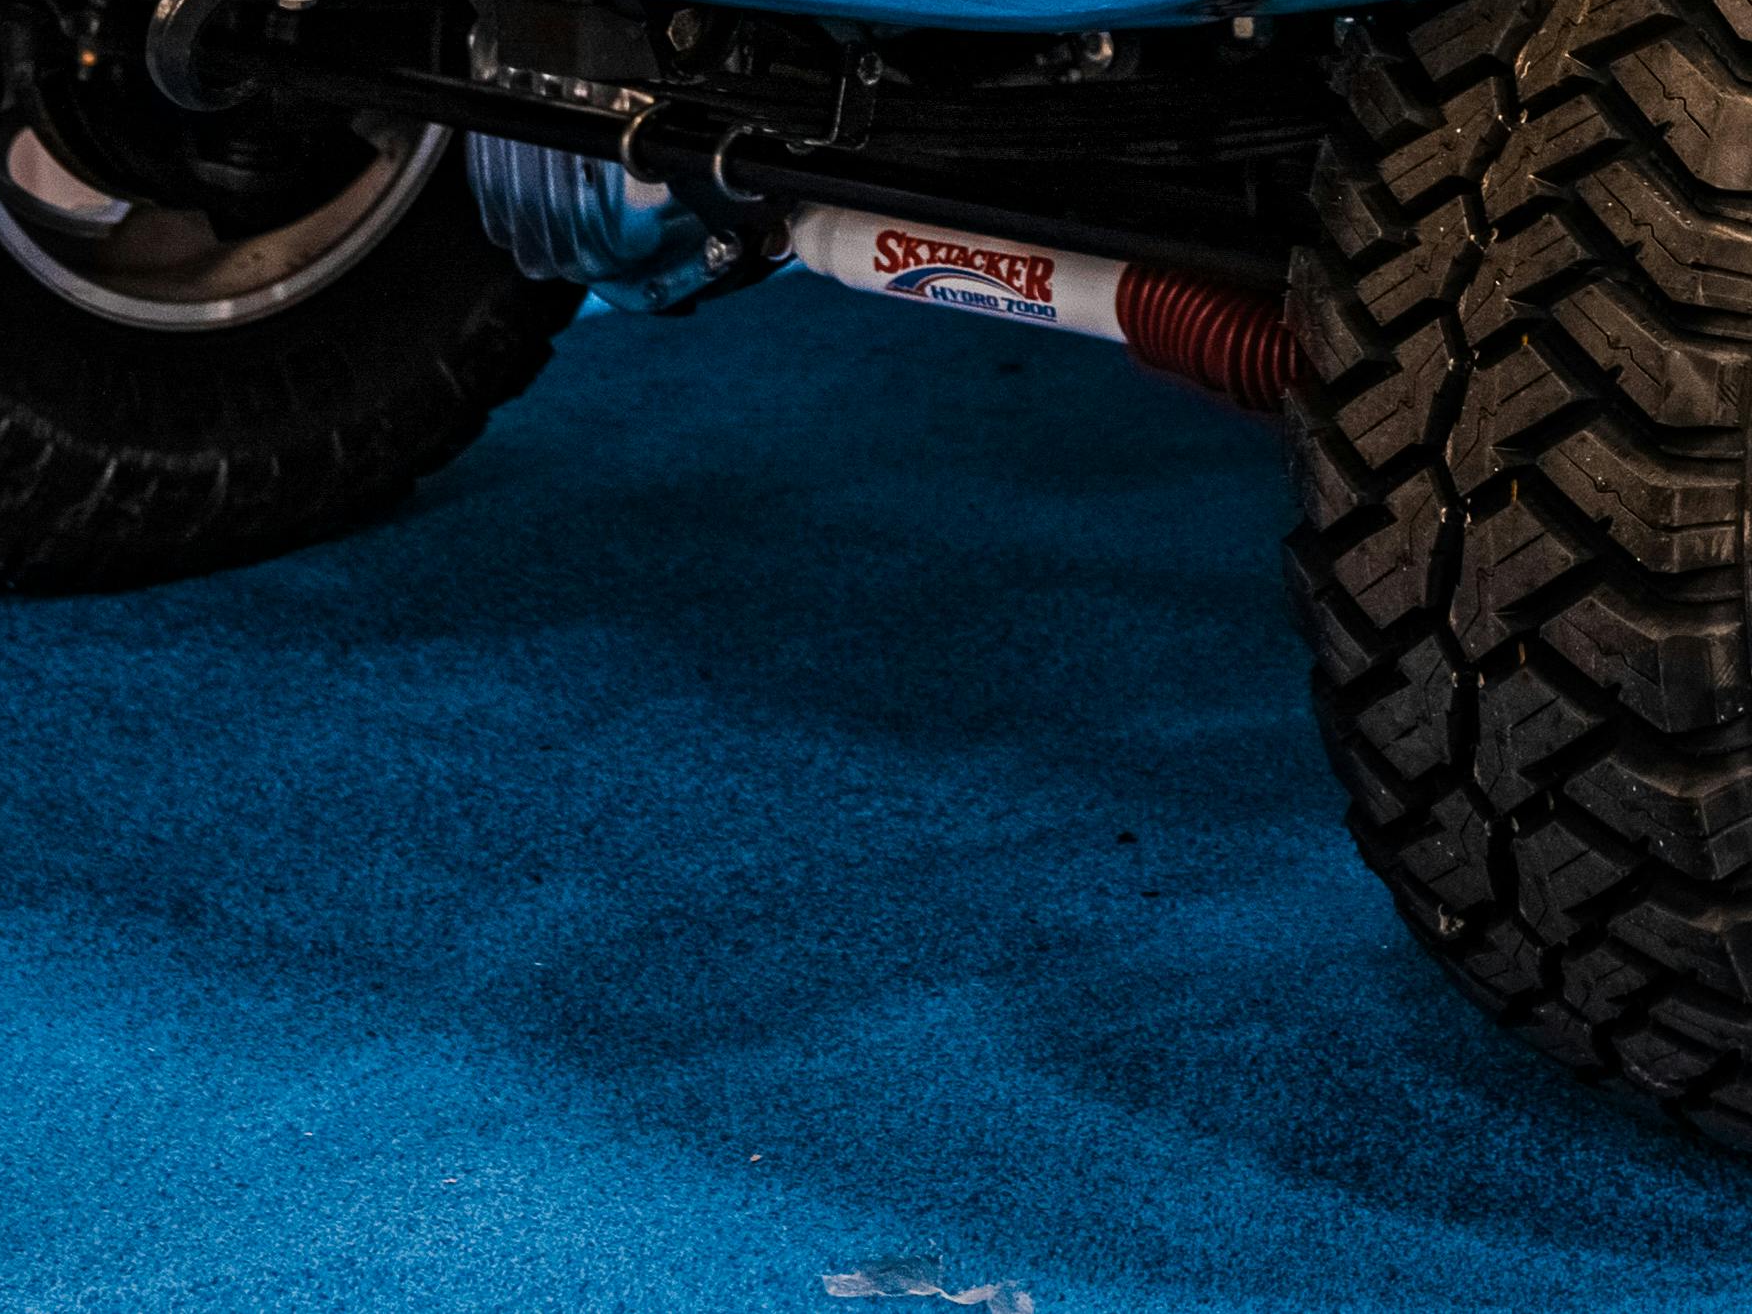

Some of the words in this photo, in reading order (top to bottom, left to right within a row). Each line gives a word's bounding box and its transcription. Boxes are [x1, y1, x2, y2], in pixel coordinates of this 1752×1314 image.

[873, 229, 1056, 304] SKYJACKER
[927, 284, 999, 309] HYDRO
[1001, 296, 1058, 319] 7000
